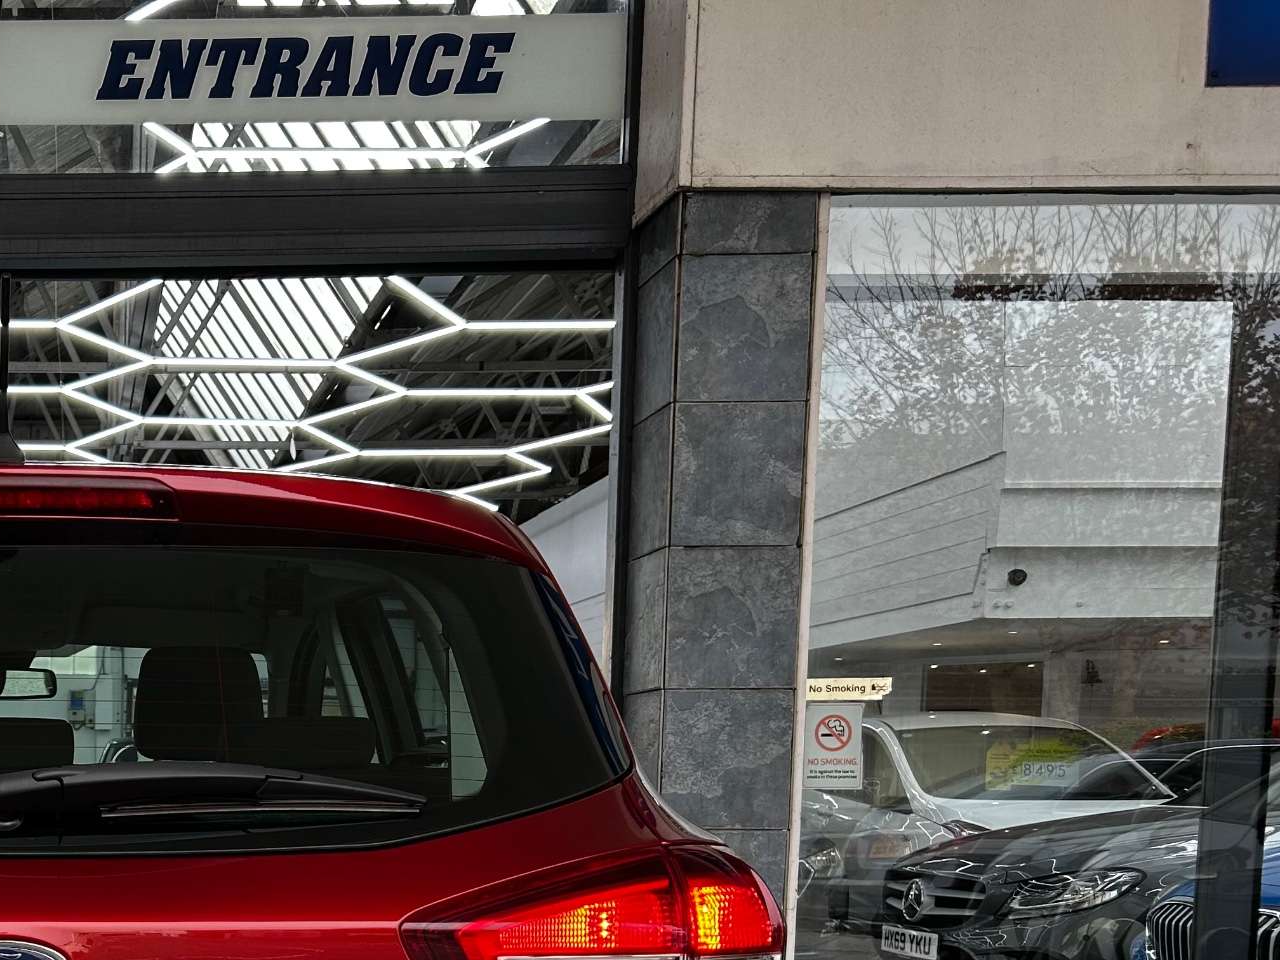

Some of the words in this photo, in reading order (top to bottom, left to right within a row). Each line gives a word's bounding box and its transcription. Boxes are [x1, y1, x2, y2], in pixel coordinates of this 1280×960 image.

[94, 32, 516, 101] ENTRANCE
[808, 684, 823, 693] No
[825, 684, 866, 694] Smoking
[807, 758, 819, 766] NO
[820, 758, 857, 766] SMOKING
[908, 933, 932, 956] YKU
